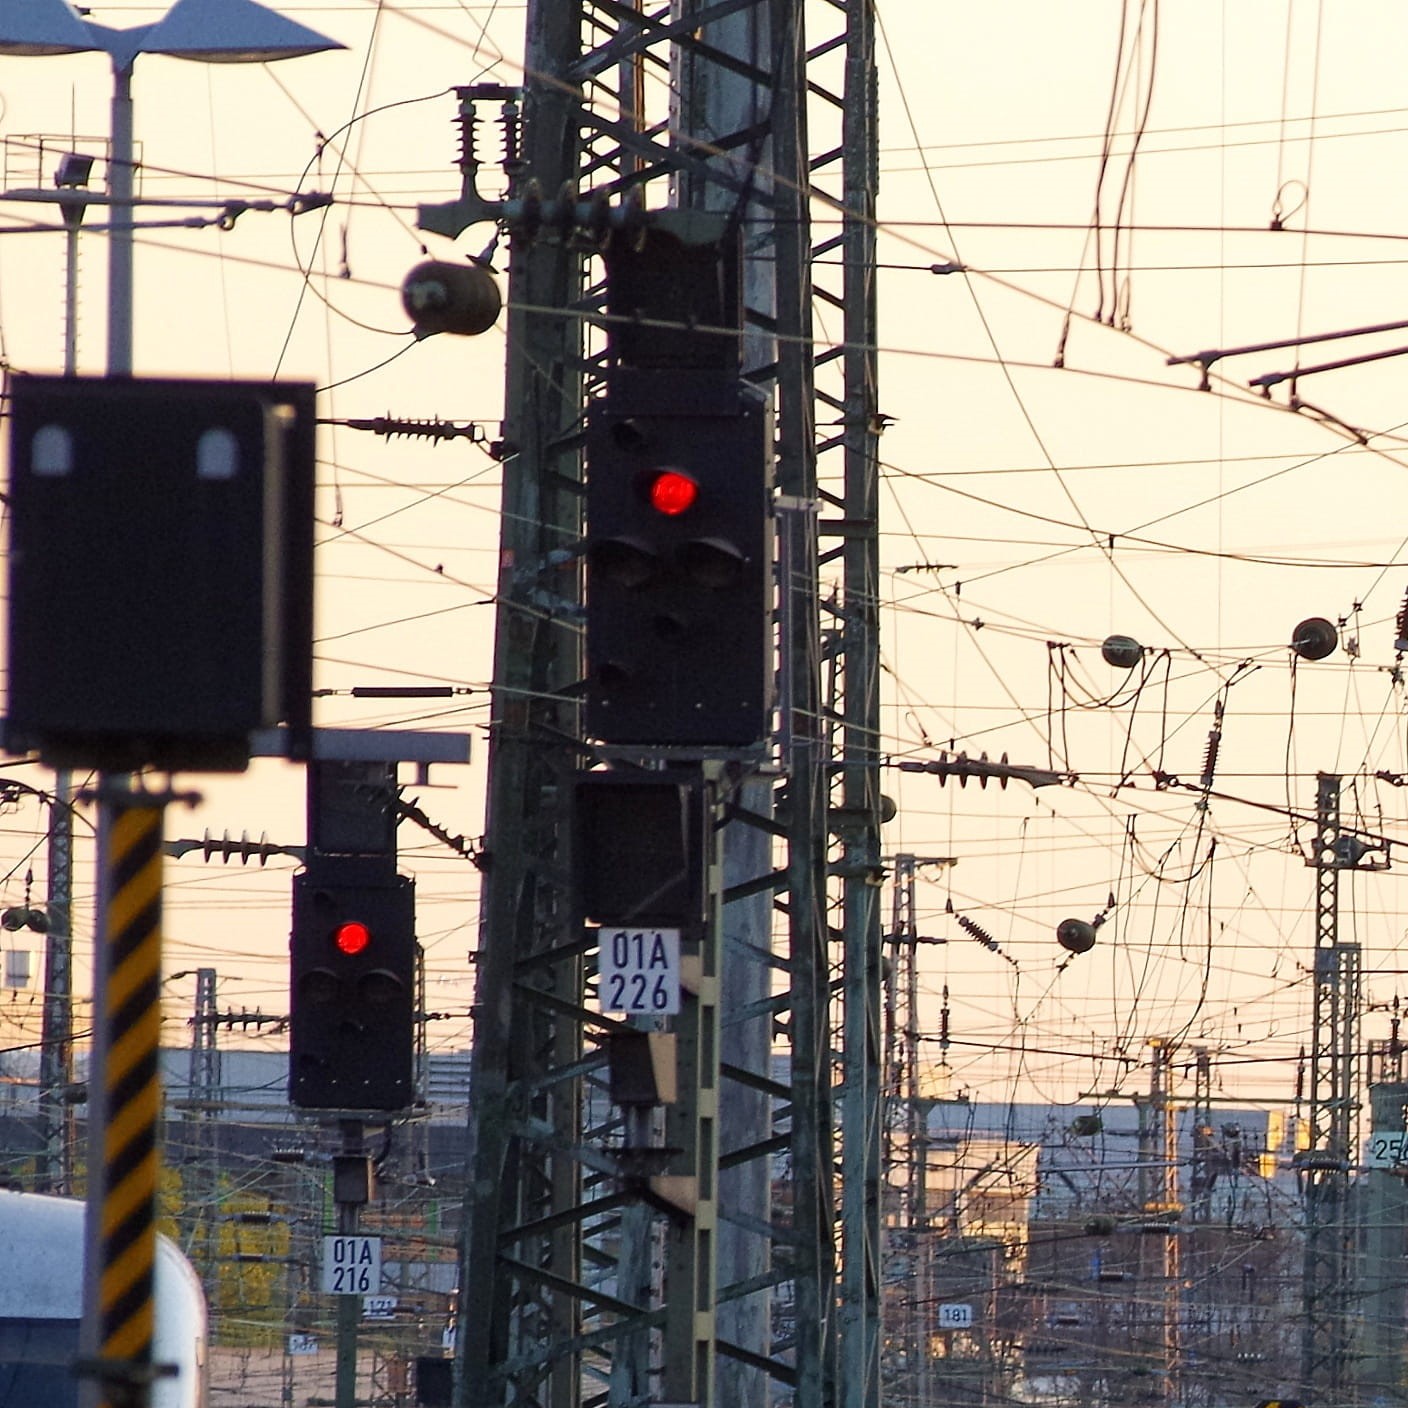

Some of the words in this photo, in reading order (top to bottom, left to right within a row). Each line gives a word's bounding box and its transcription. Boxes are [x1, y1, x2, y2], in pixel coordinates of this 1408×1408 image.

[612, 932, 668, 969] 01A
[610, 974, 668, 1009] 226
[333, 1239, 372, 1265] 01A
[333, 1267, 370, 1292] 216
[944, 1308, 967, 1322] 181
